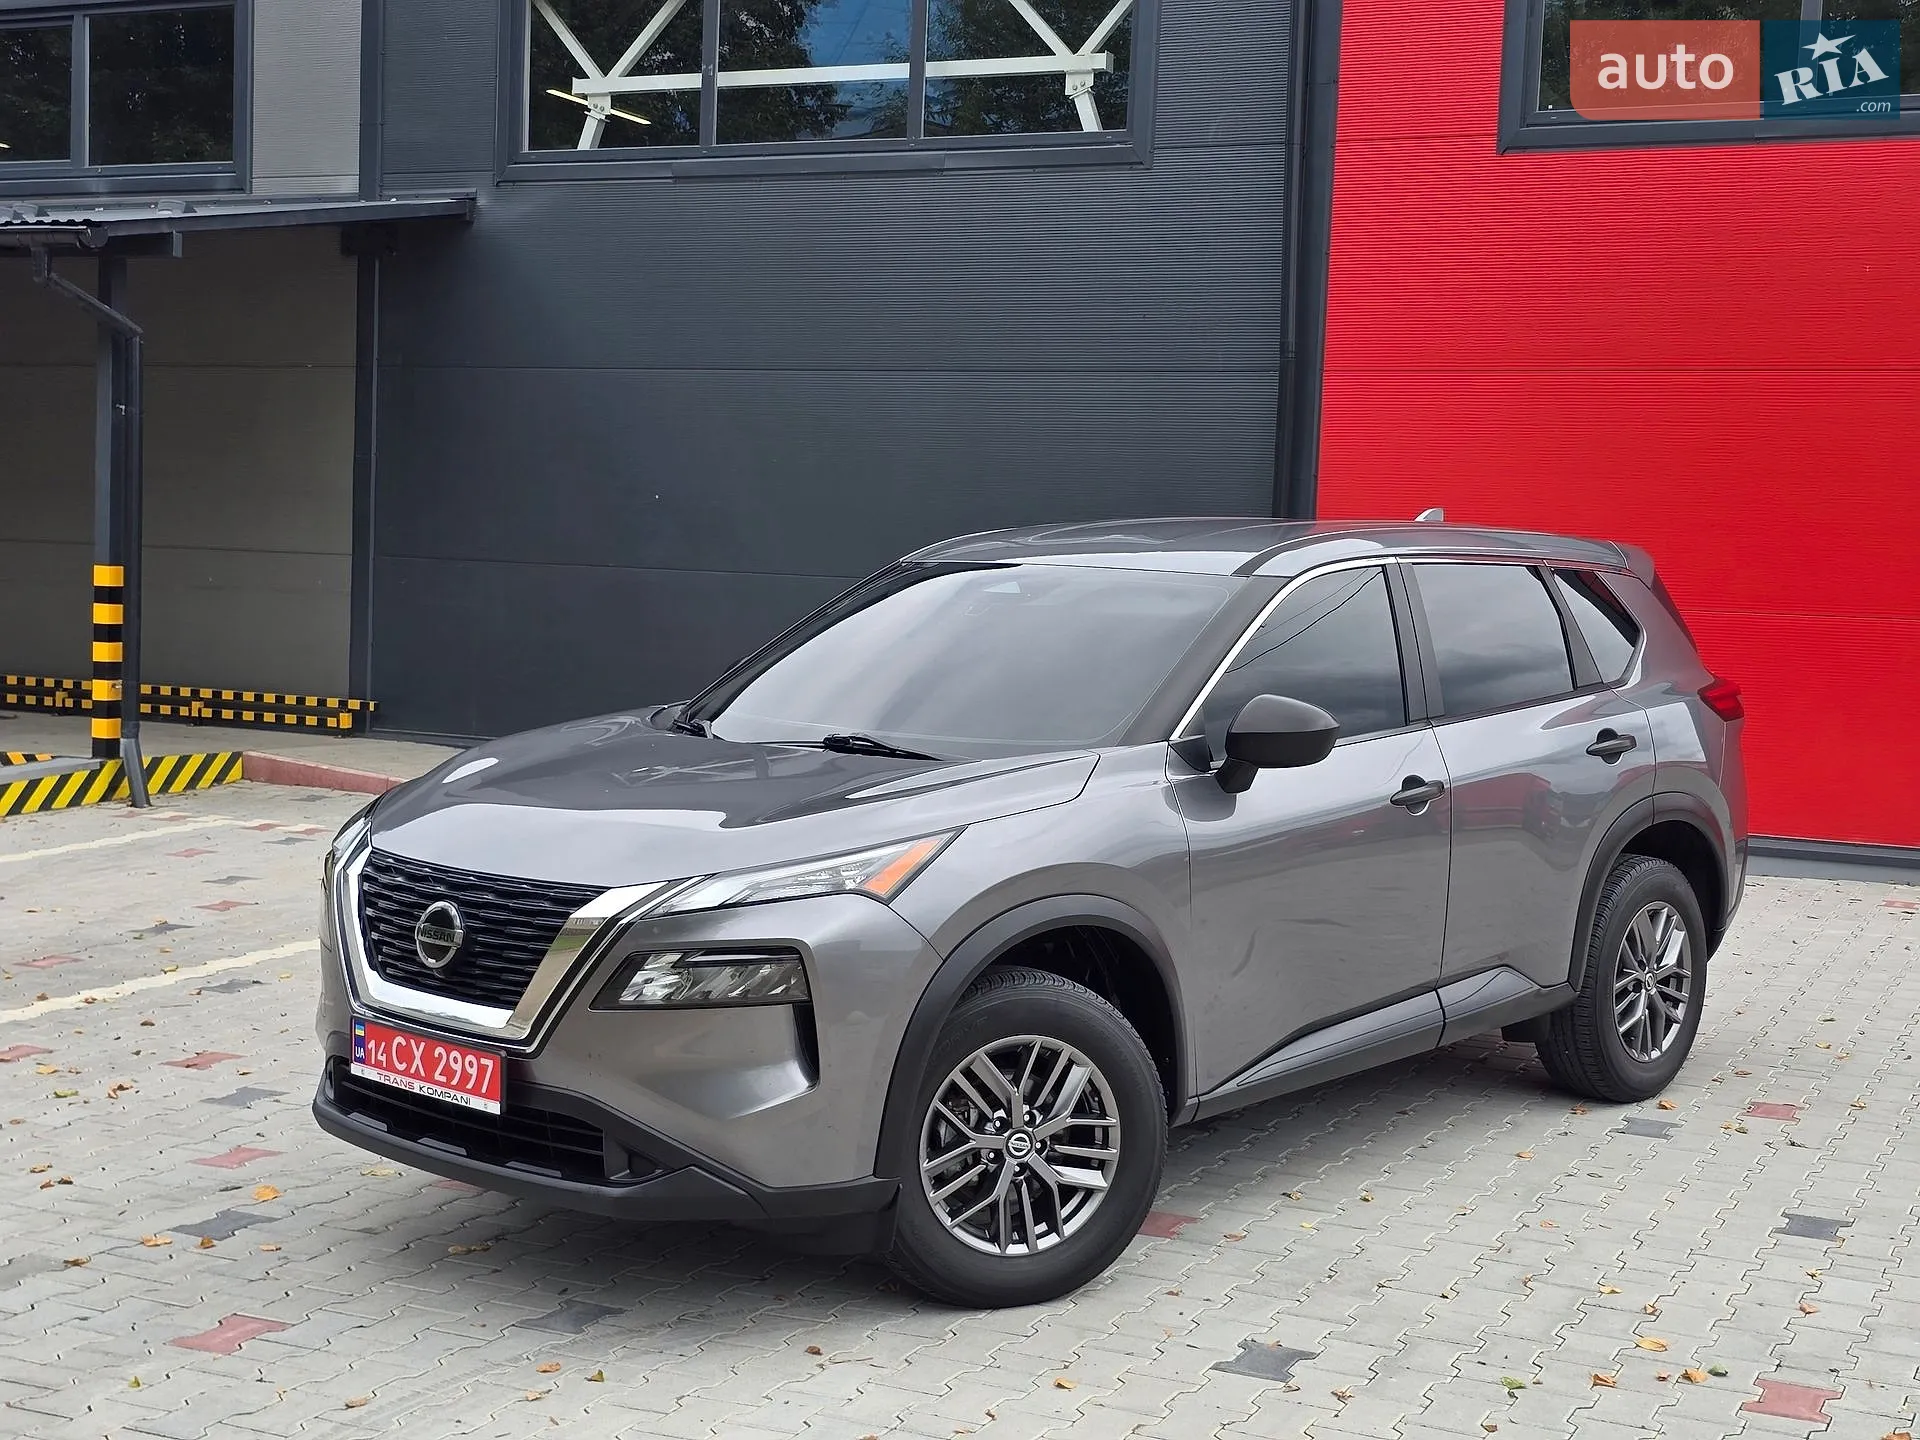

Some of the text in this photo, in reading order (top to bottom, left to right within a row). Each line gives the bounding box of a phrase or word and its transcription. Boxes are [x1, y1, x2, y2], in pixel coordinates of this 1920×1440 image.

[420, 926, 455, 943] NISSAN
[355, 1046, 365, 1059] UA
[368, 1035, 494, 1094] 14 CX 2997
[377, 1072, 471, 1106] TRANS KOMPANI
